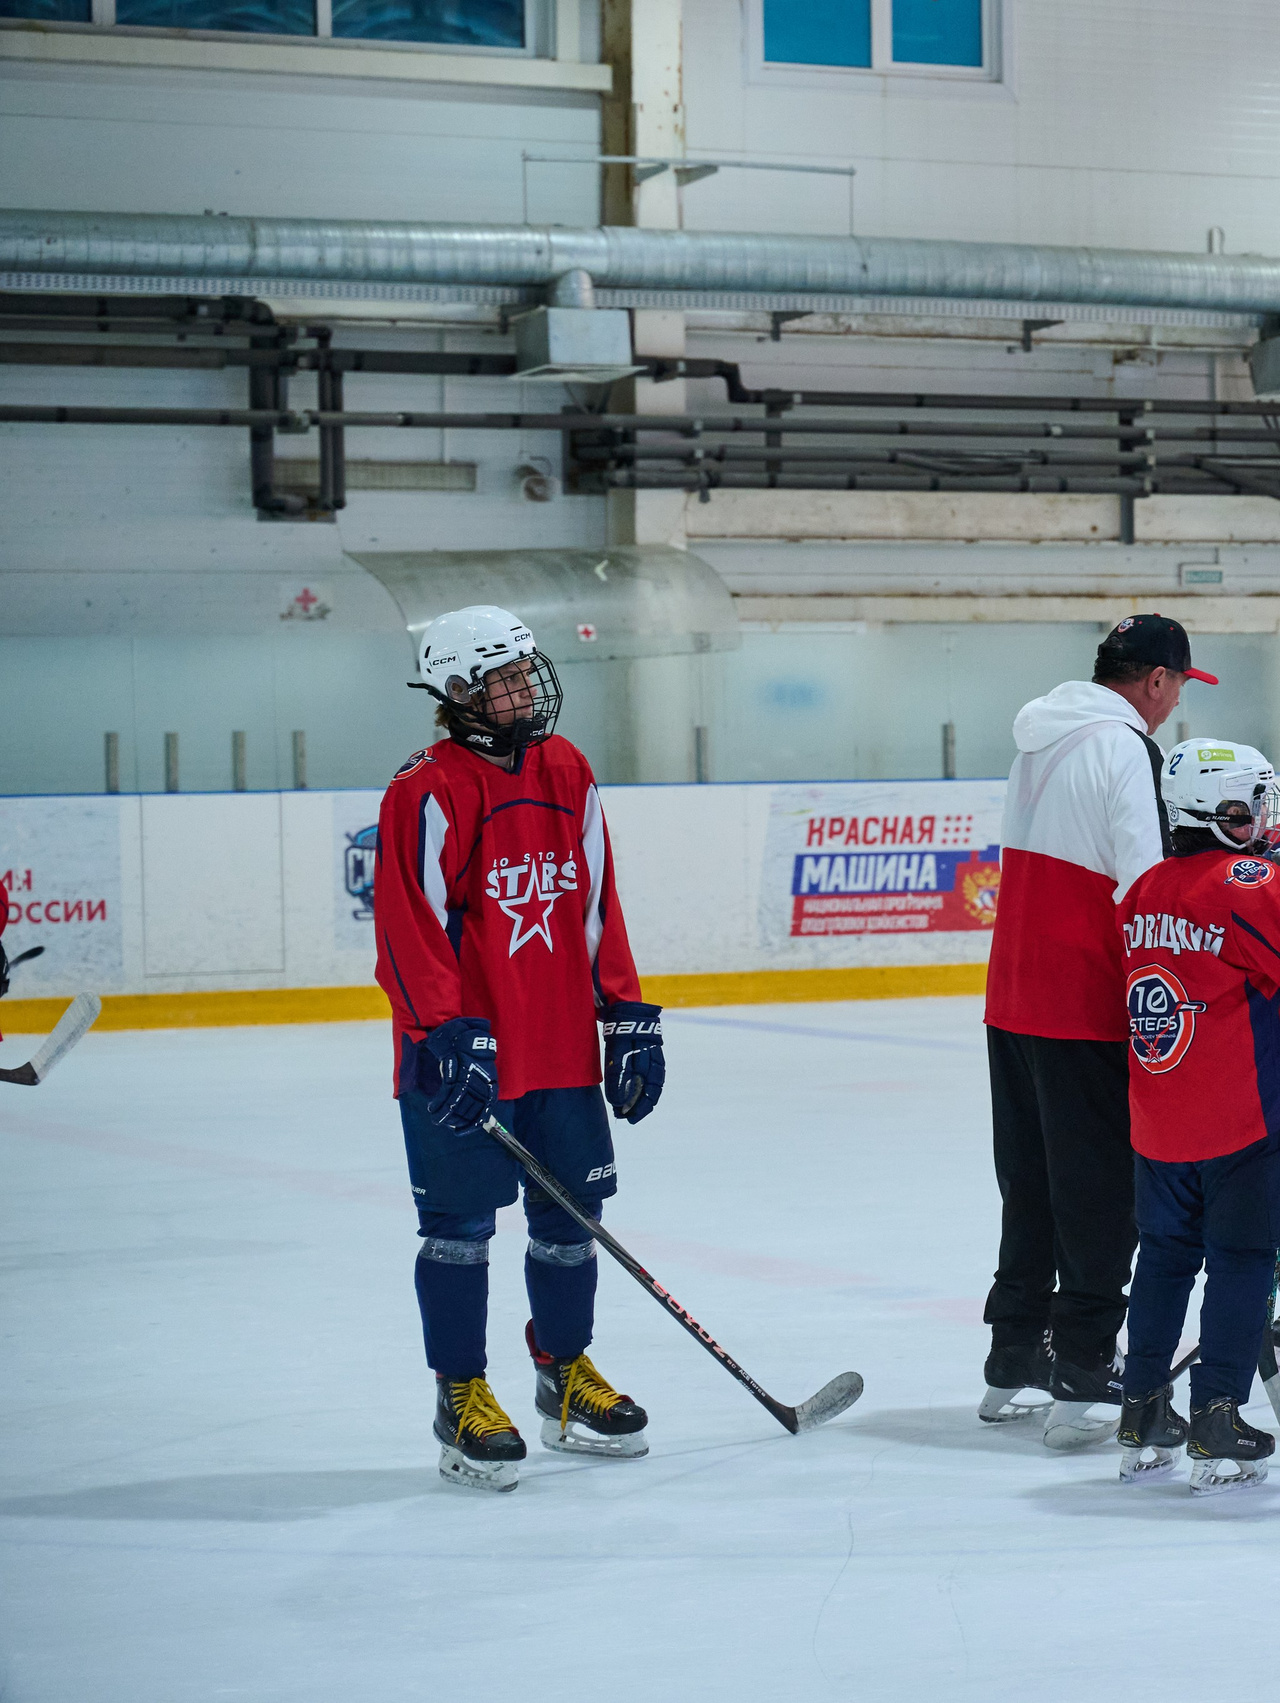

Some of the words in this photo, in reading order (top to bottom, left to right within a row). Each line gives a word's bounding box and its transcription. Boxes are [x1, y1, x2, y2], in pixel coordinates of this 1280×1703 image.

[514, 633, 531, 642] CCM
[432, 655, 456, 666] CCM
[531, 729, 545, 737] CC
[806, 815, 936, 847] КРАСНАЯ
[800, 854, 937, 893] МАШИНА
[6, 900, 106, 923] ОССИИ
[1136, 986, 1168, 1013] 10
[603, 1021, 663, 1036] BAUE
[1129, 1015, 1178, 1032] STEPS
[651, 1280, 726, 1358] SOYUZ
